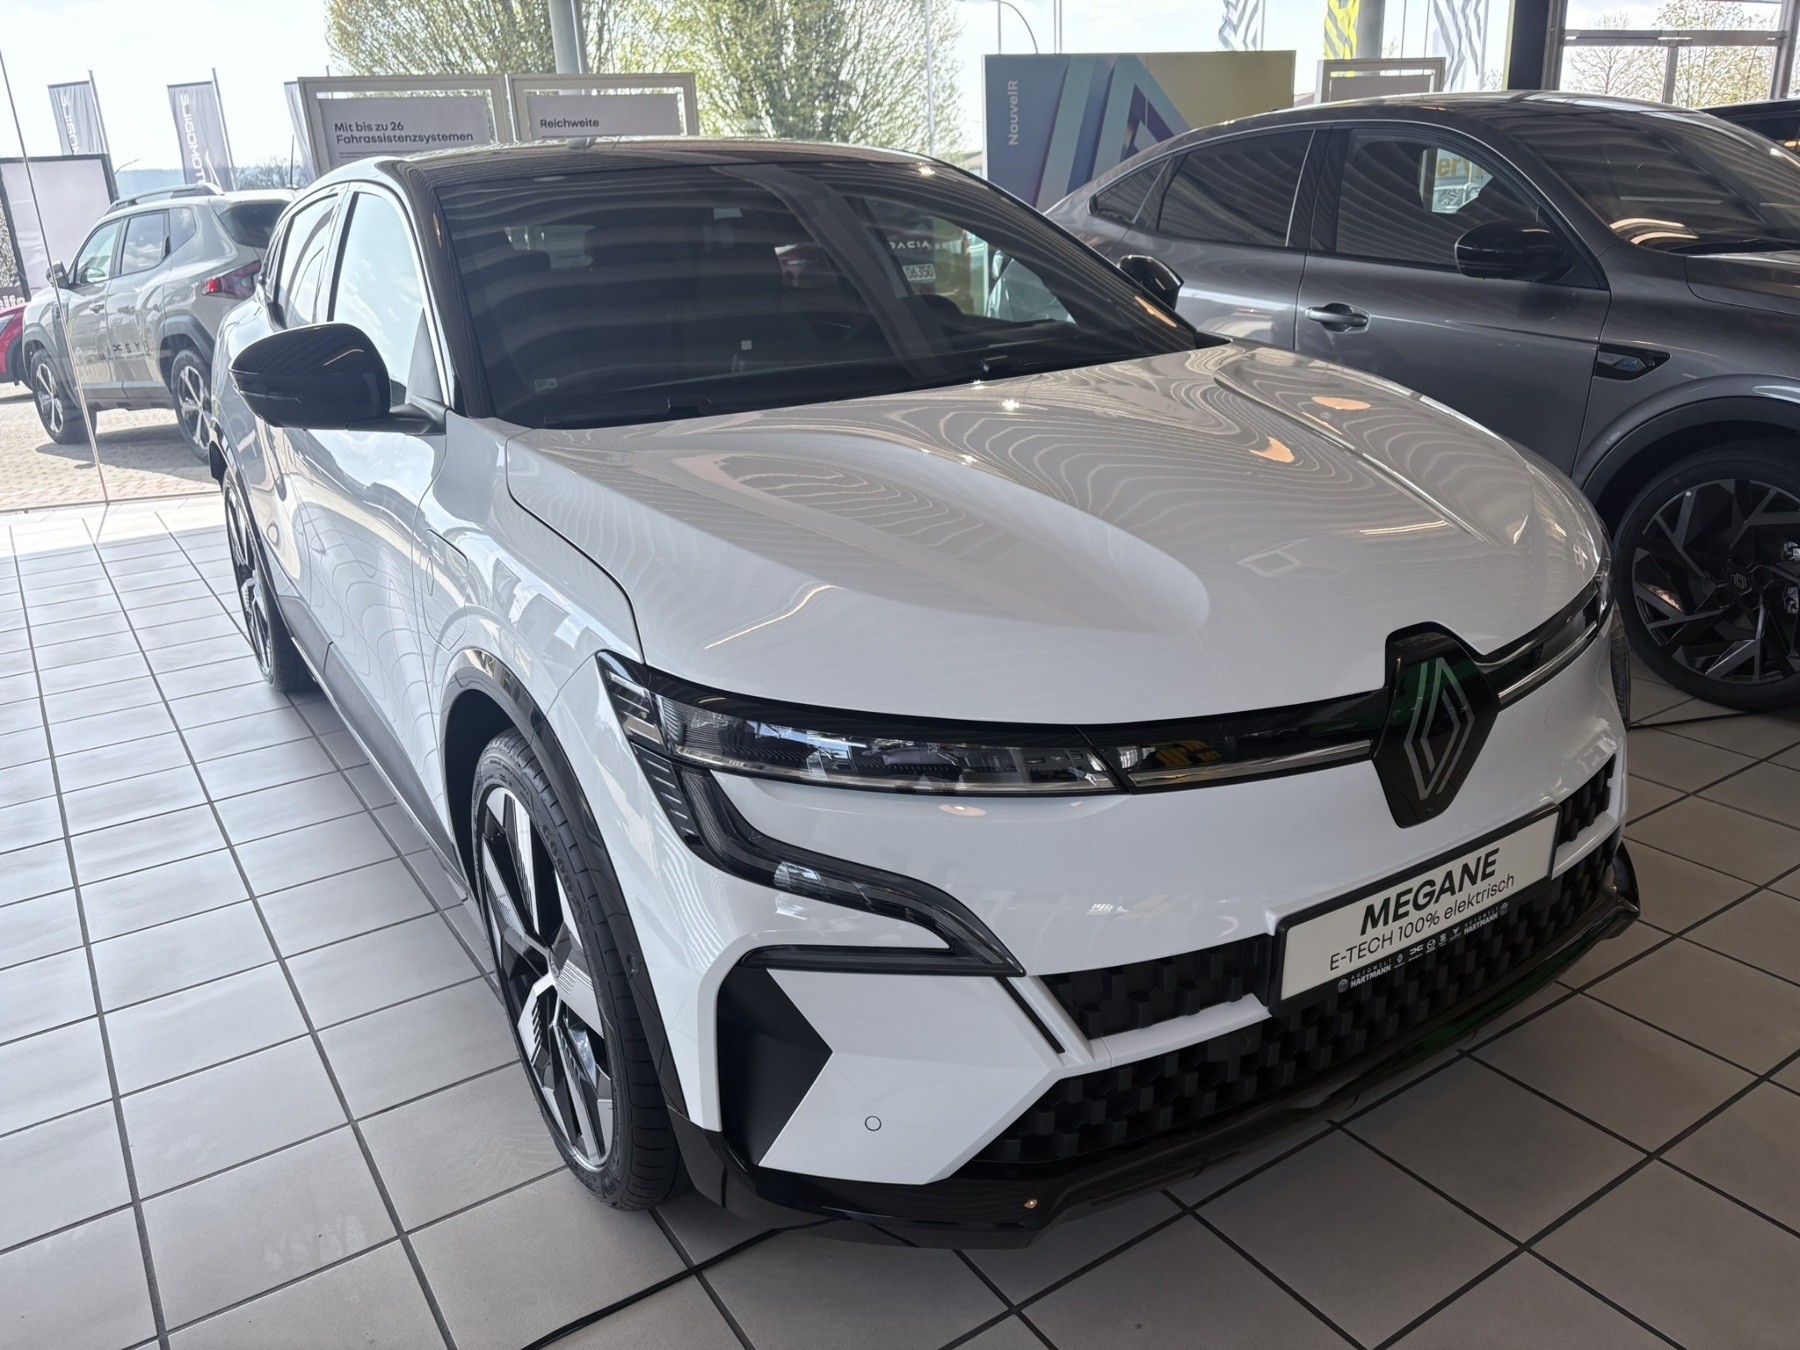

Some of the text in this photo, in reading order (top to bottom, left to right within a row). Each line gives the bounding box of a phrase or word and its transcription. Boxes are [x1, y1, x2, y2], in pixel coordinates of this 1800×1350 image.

[334, 121, 405, 133] Mit bis zu 26
[540, 118, 600, 129] Reichweite
[336, 132, 474, 145] Fahrassistenzsystemen
[1360, 847, 1500, 937] MEGANE
[1330, 872, 1515, 971] E-TECH 100% elektrisch
[1463, 912, 1499, 935] HARTMANN
[1350, 963, 1392, 988] HARTMANN
